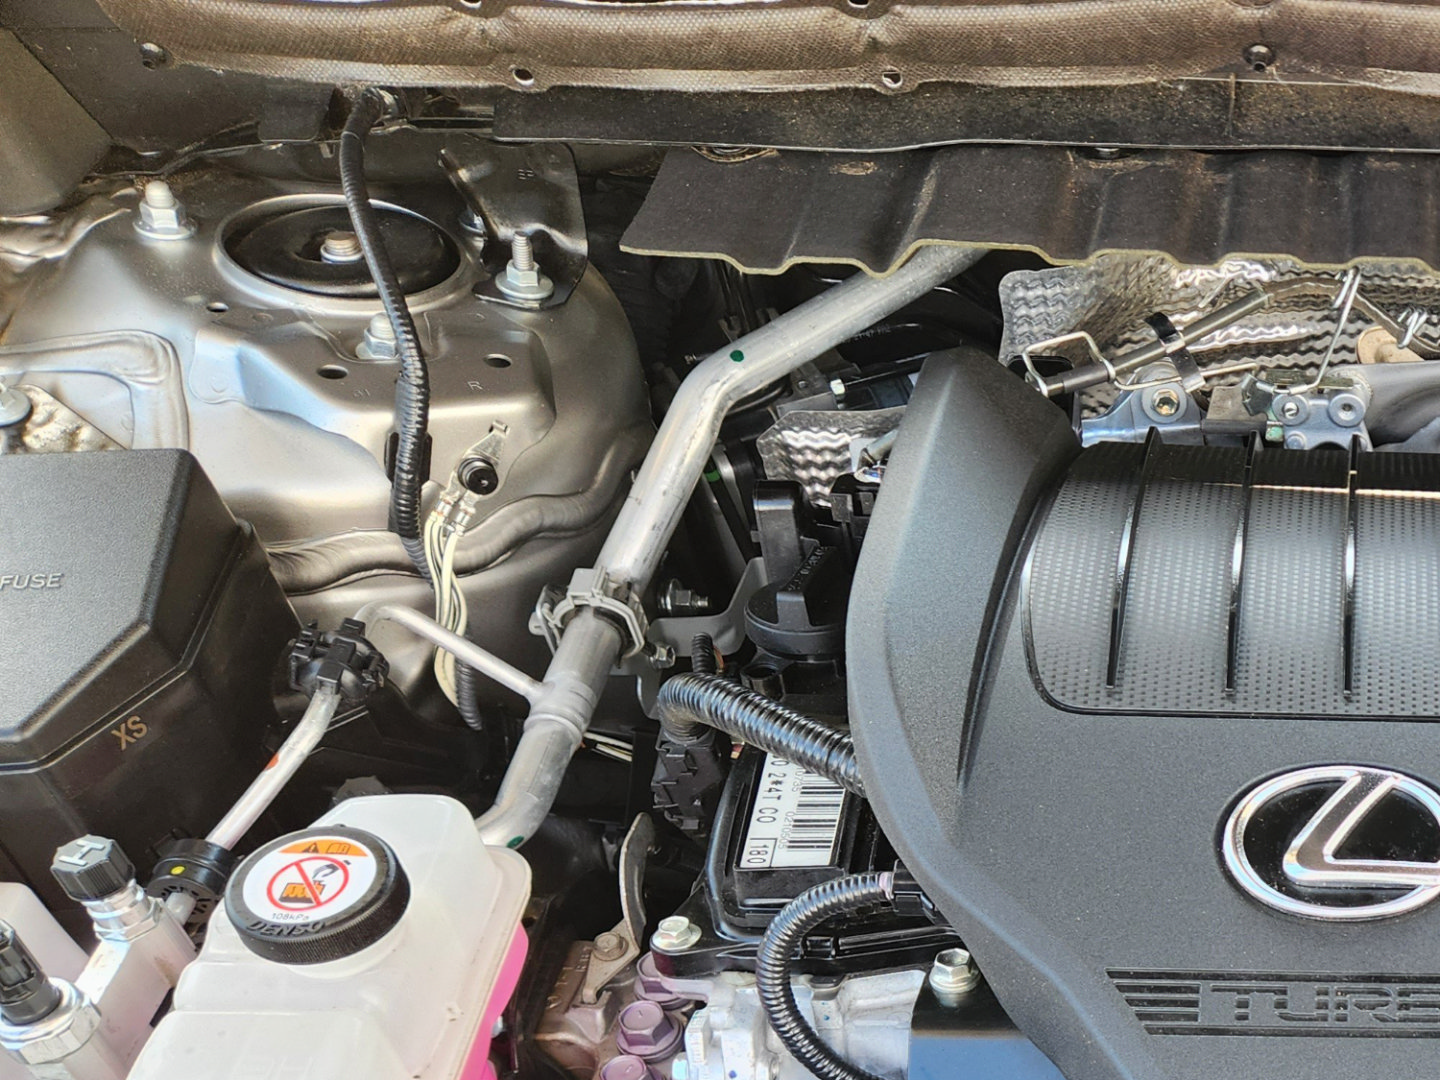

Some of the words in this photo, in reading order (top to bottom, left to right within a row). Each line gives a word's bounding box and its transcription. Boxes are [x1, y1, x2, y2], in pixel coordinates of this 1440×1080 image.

[0, 572, 63, 590] FUSE
[111, 715, 148, 751] XS
[746, 844, 769, 864] 180
[246, 920, 326, 937] DENSO
